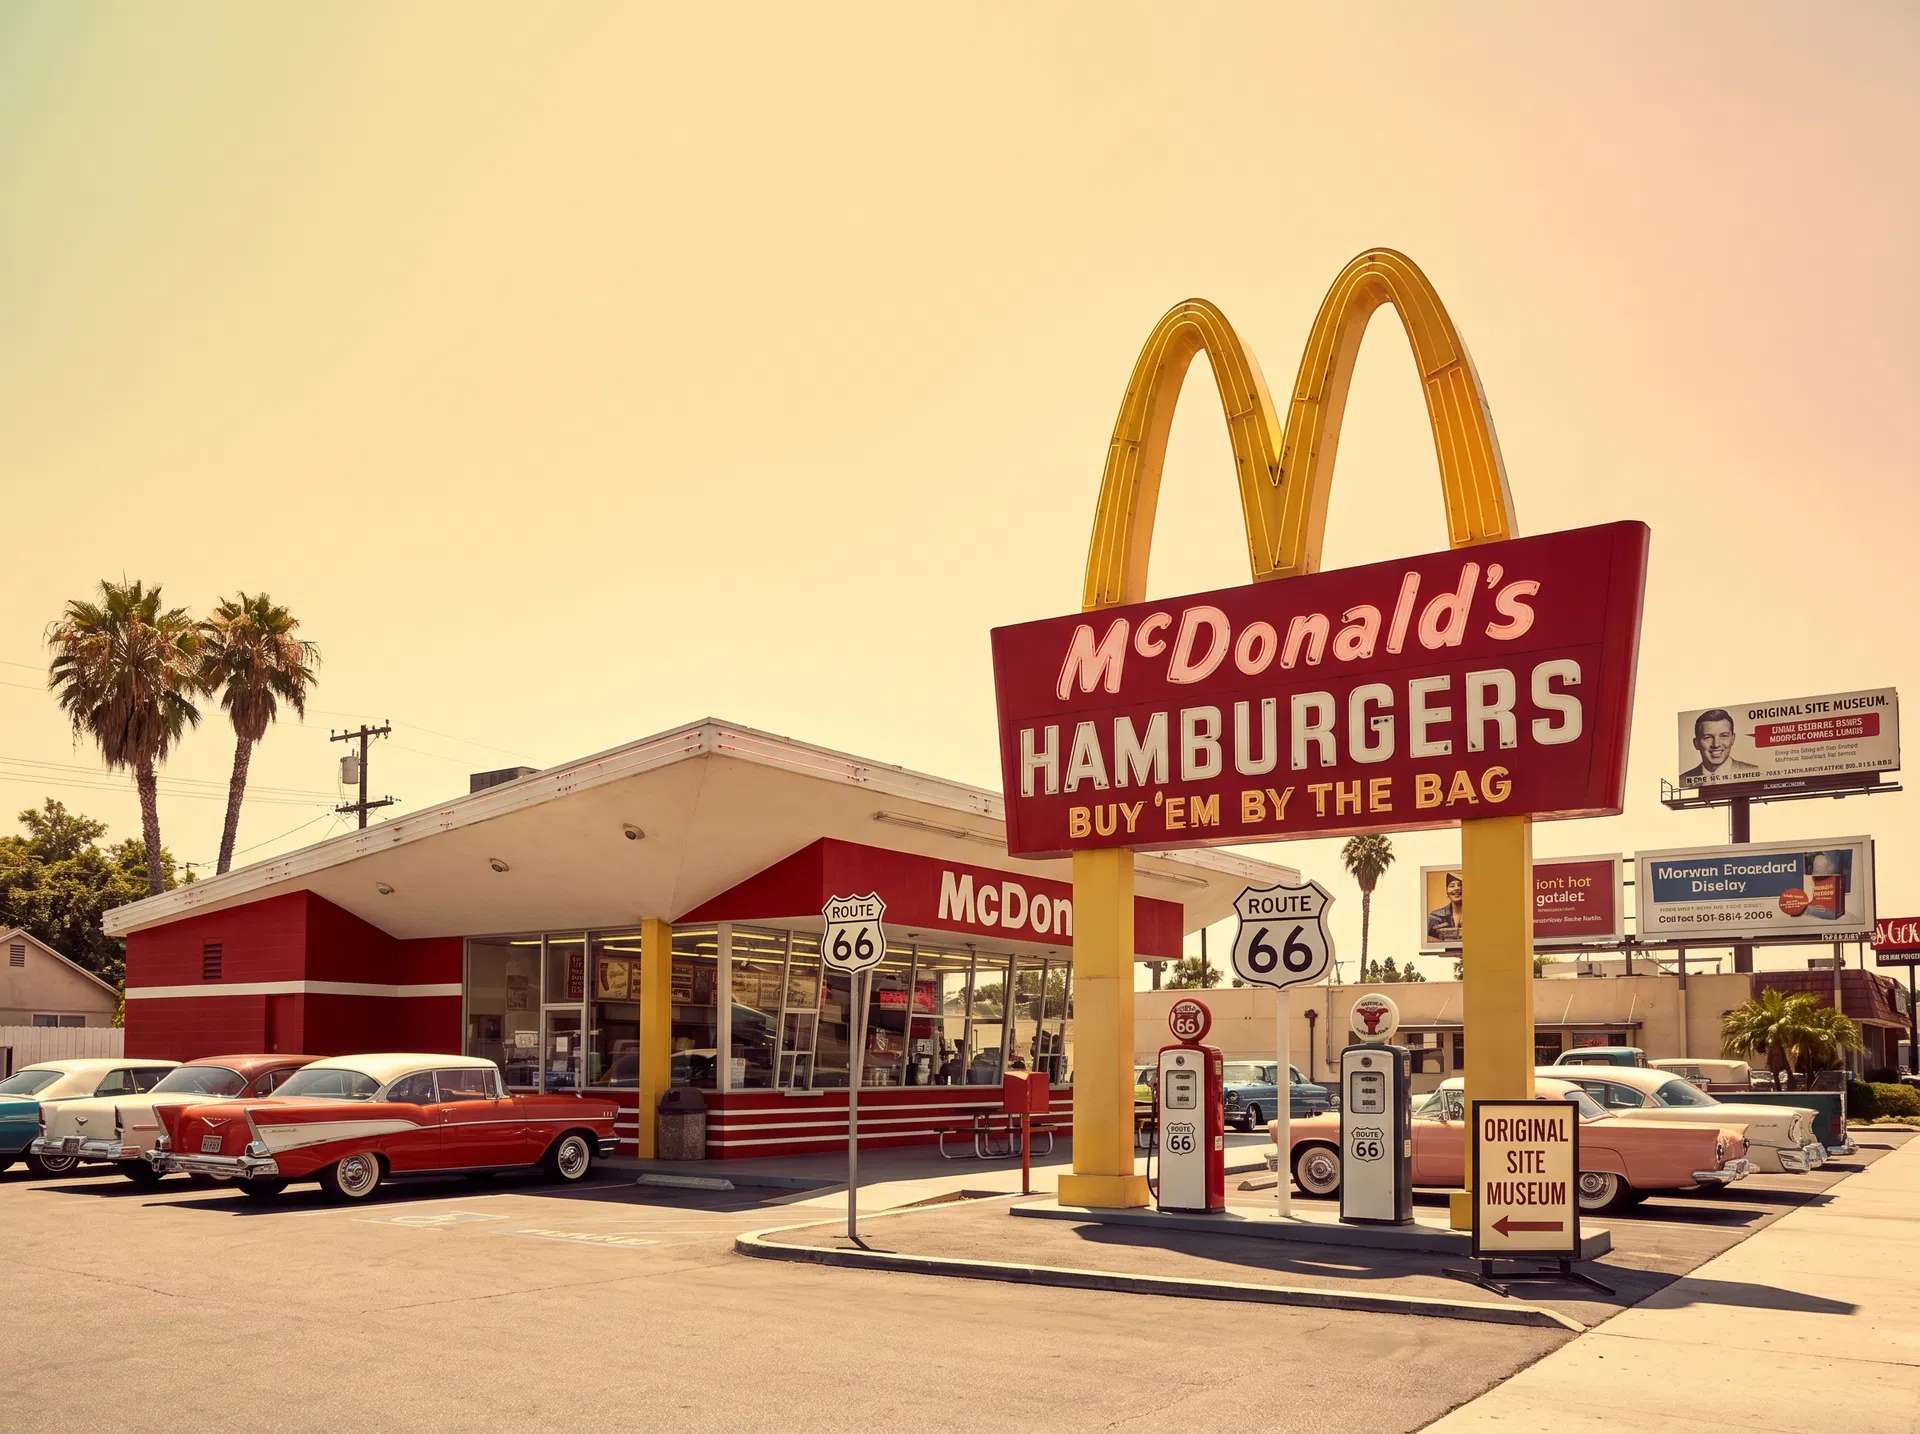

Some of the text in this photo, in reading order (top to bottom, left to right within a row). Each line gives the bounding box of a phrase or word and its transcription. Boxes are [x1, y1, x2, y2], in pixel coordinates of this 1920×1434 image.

[1056, 562, 1541, 701] McDonald's
[1748, 705, 1803, 720] ORIGINAL
[1805, 701, 1830, 714] SITE
[1020, 658, 1582, 798] HAMBURGERS
[1069, 765, 1512, 838] BUY 'EM BY THE BAG
[1568, 876, 1592, 888] hot
[832, 904, 874, 919] ROUTE
[938, 870, 1073, 937] McDon
[1248, 895, 1311, 914] ROUTE
[832, 927, 874, 961] 66
[1248, 925, 1312, 973] 66
[1176, 1018, 1195, 1033] 66
[1484, 1118, 1568, 1142] ORIGINAL
[1171, 1135, 1191, 1151] 66
[1356, 1141, 1378, 1157] 66
[1506, 1150, 1545, 1174] SITE
[1486, 1182, 1566, 1206] MUSEUM
